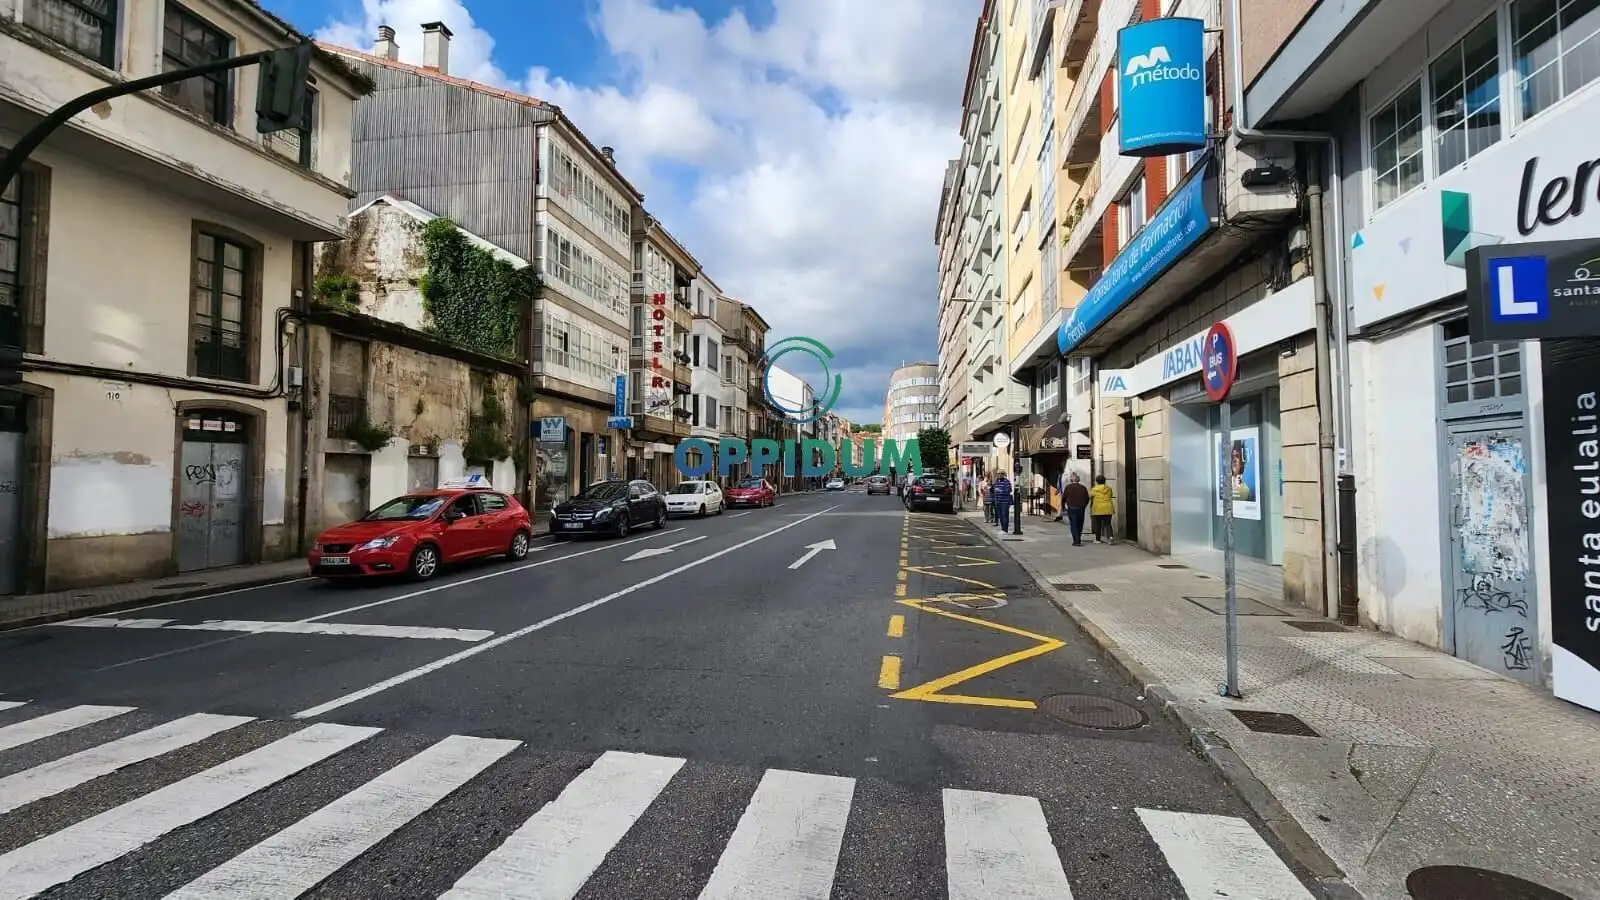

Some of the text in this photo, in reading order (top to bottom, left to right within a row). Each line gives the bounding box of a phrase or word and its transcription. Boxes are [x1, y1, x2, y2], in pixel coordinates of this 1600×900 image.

[1130, 63, 1200, 91] método
[1128, 246, 1140, 270] de
[1498, 266, 1538, 316] L
[1553, 285, 1600, 297] santa
[652, 294, 666, 369] HOTEL
[1213, 333, 1218, 350] P
[1209, 352, 1223, 368] BUS
[1571, 391, 1600, 632] santa eulalia
